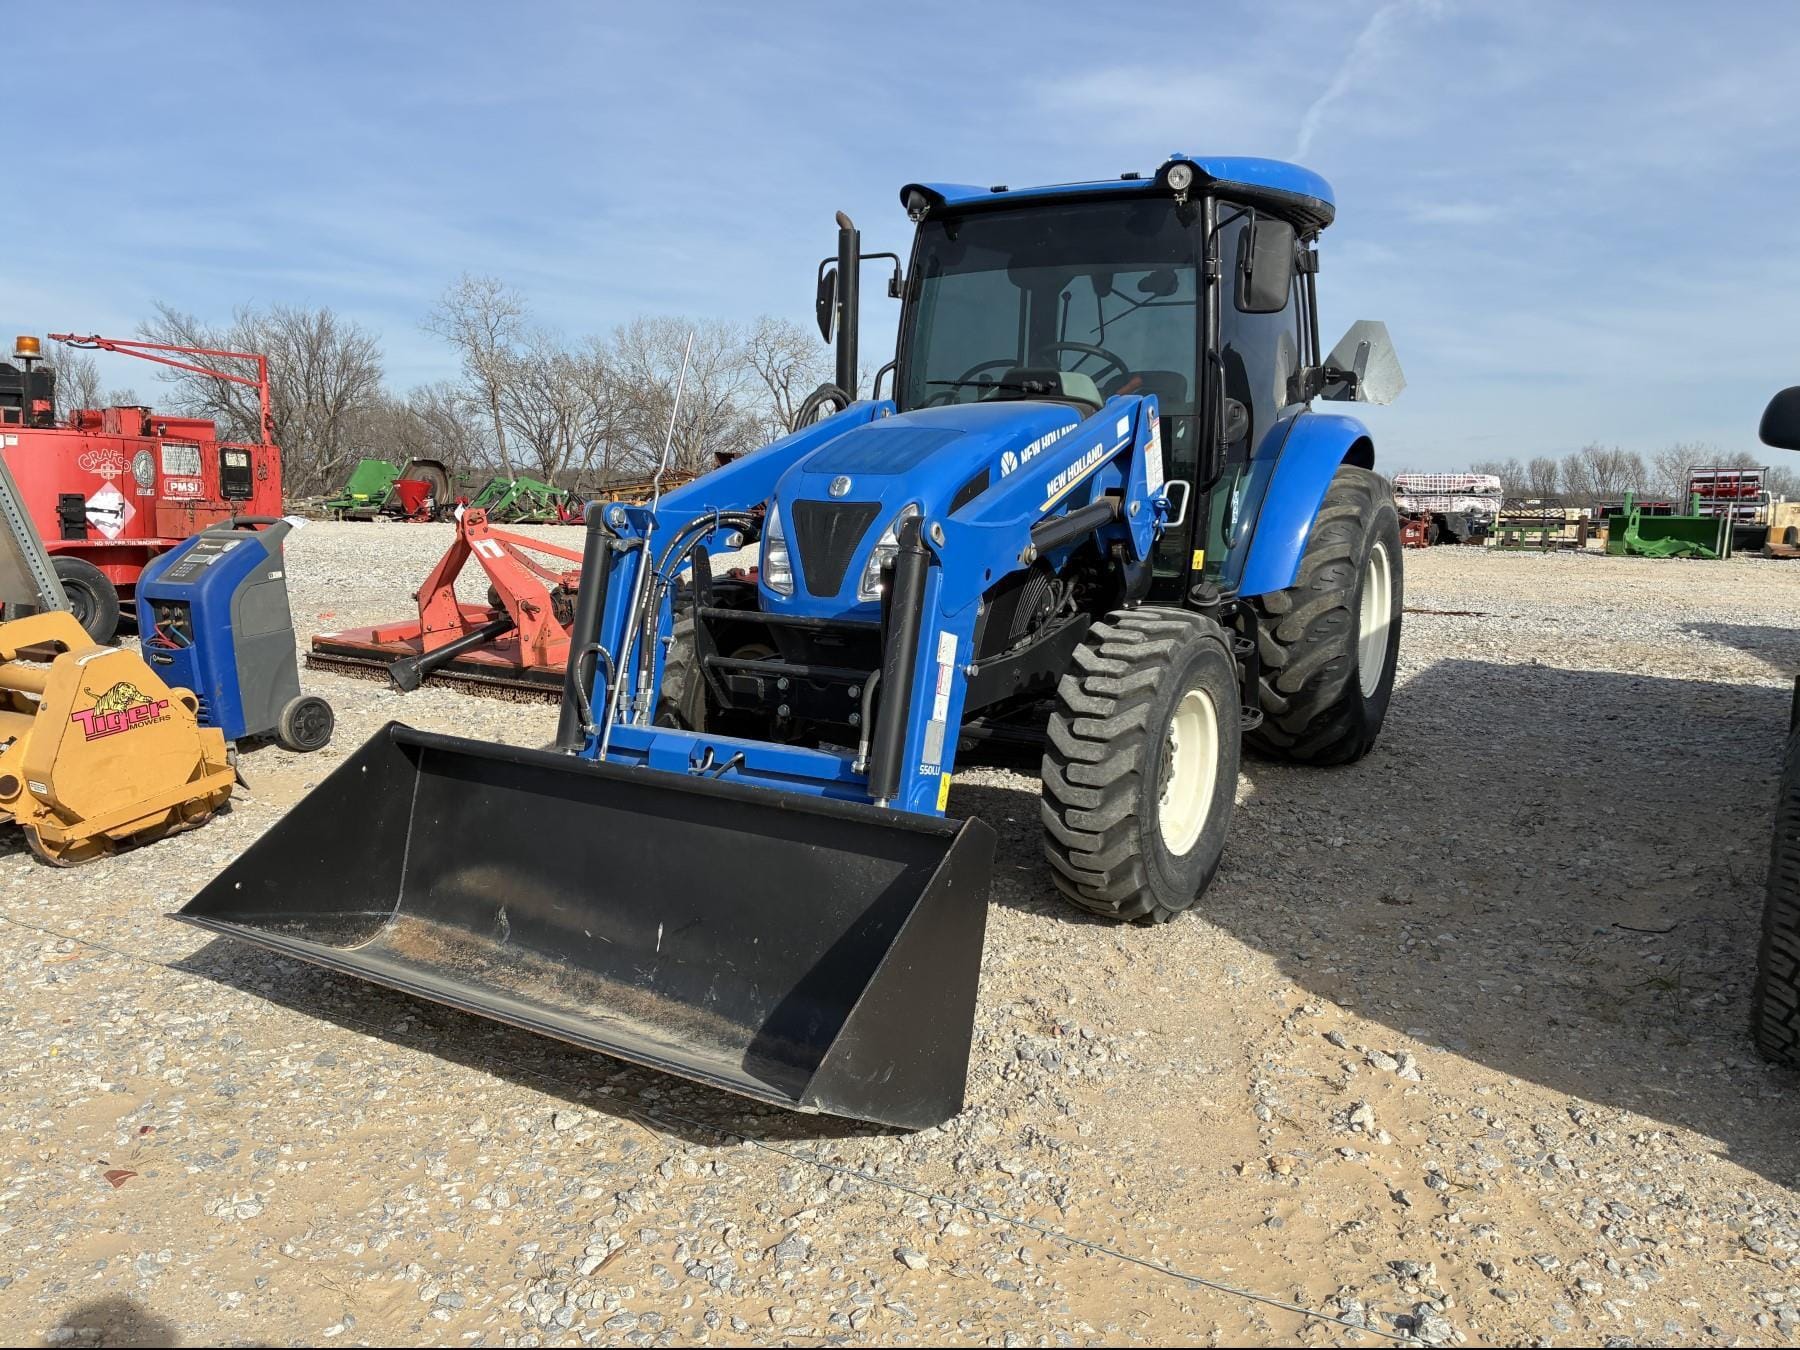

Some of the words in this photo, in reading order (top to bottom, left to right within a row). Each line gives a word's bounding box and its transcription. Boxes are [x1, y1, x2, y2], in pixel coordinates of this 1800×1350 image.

[78, 448, 132, 472] CRAFCO
[1046, 470, 1067, 499] NEW
[1067, 442, 1103, 482] HOLLAND
[170, 482, 198, 492] PMSI
[71, 699, 169, 737] Tiger
[129, 714, 171, 731] MOWERS
